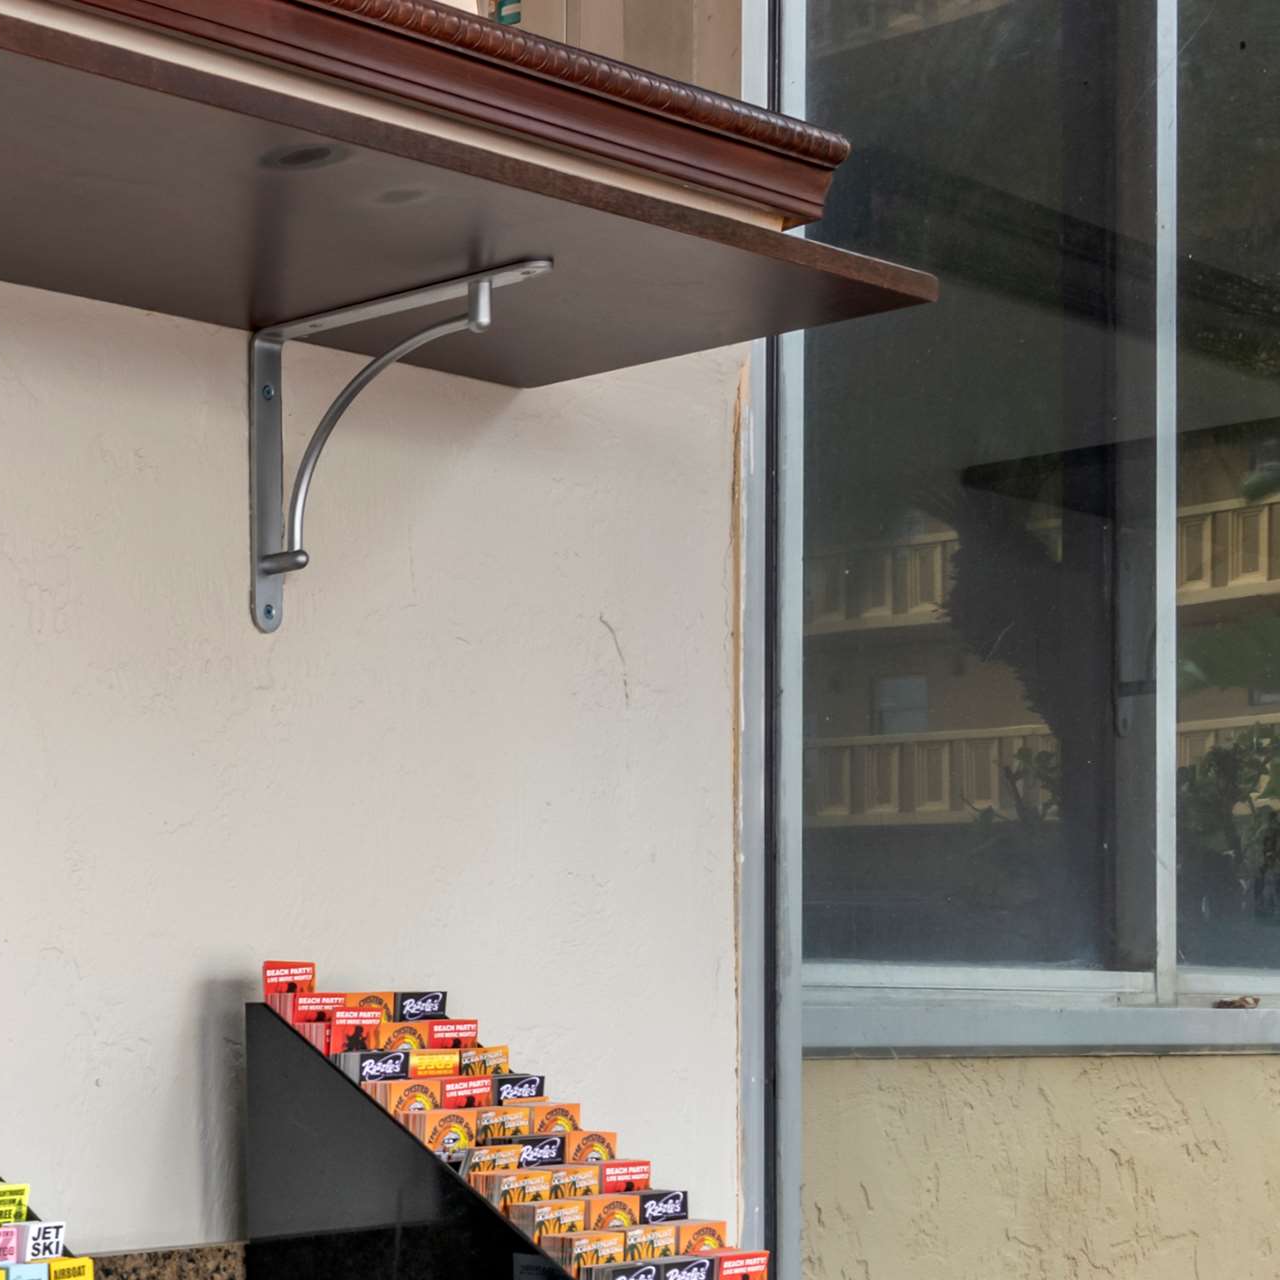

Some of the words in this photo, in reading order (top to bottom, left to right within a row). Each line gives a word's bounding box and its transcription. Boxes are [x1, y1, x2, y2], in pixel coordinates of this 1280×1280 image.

[266, 968, 289, 976] BEACH
[445, 1083, 467, 1091] BEACH
[606, 1167, 627, 1175] BEACH
[644, 1200, 681, 1217] Razzle's
[32, 1225, 63, 1241] JET
[31, 1241, 60, 1257] SKI
[723, 1260, 744, 1268] BEACH
[54, 1265, 86, 1280] AIRBOAT
